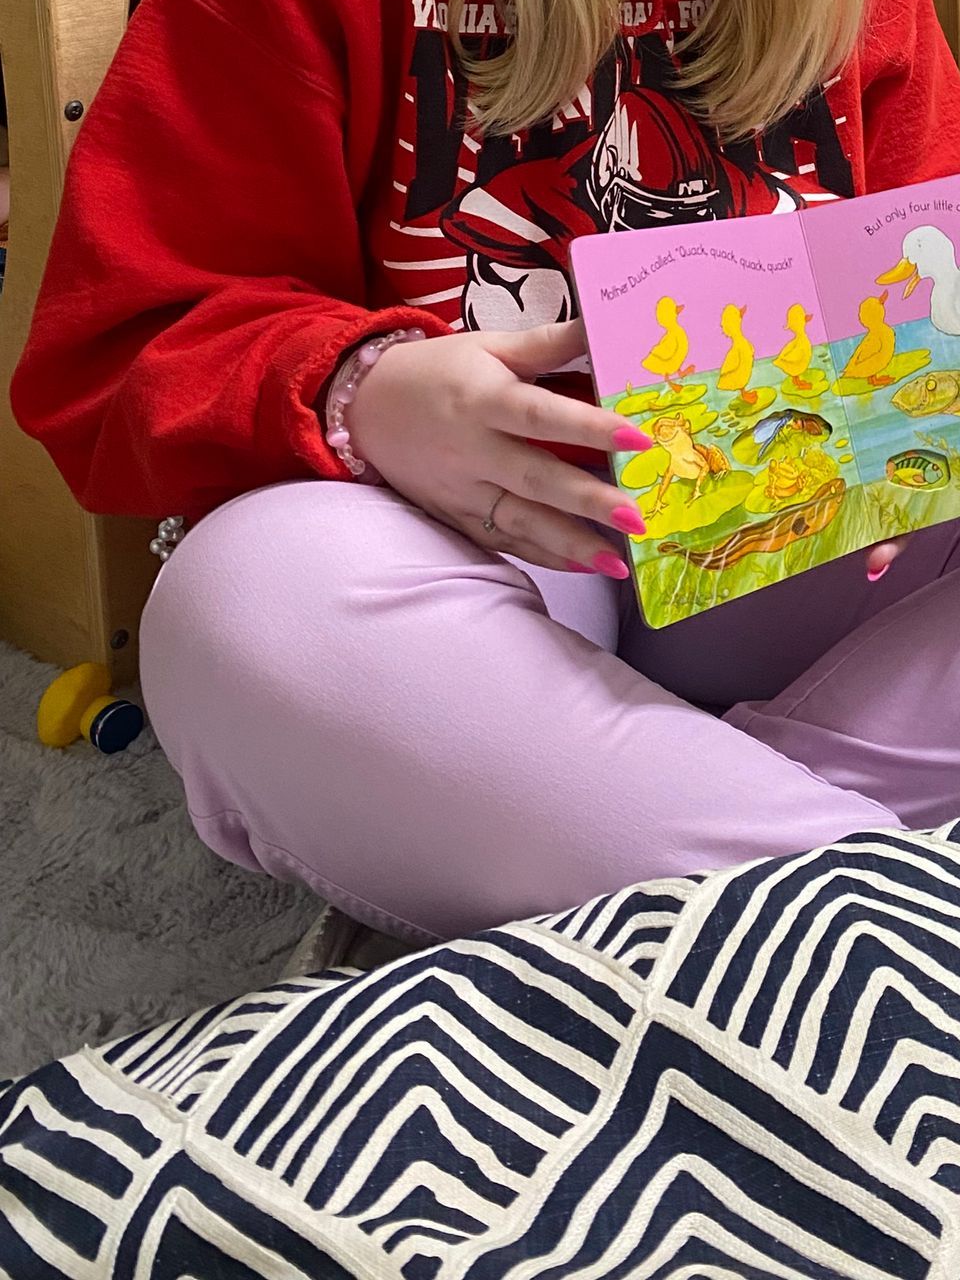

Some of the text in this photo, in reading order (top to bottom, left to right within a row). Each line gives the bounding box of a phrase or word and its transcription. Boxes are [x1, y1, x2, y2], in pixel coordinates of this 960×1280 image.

[864, 217, 884, 236] But
[885, 207, 907, 223] only
[909, 202, 930, 213] four
[933, 200, 953, 212] little
[600, 282, 628, 301] Mother
[627, 266, 650, 288] Duck
